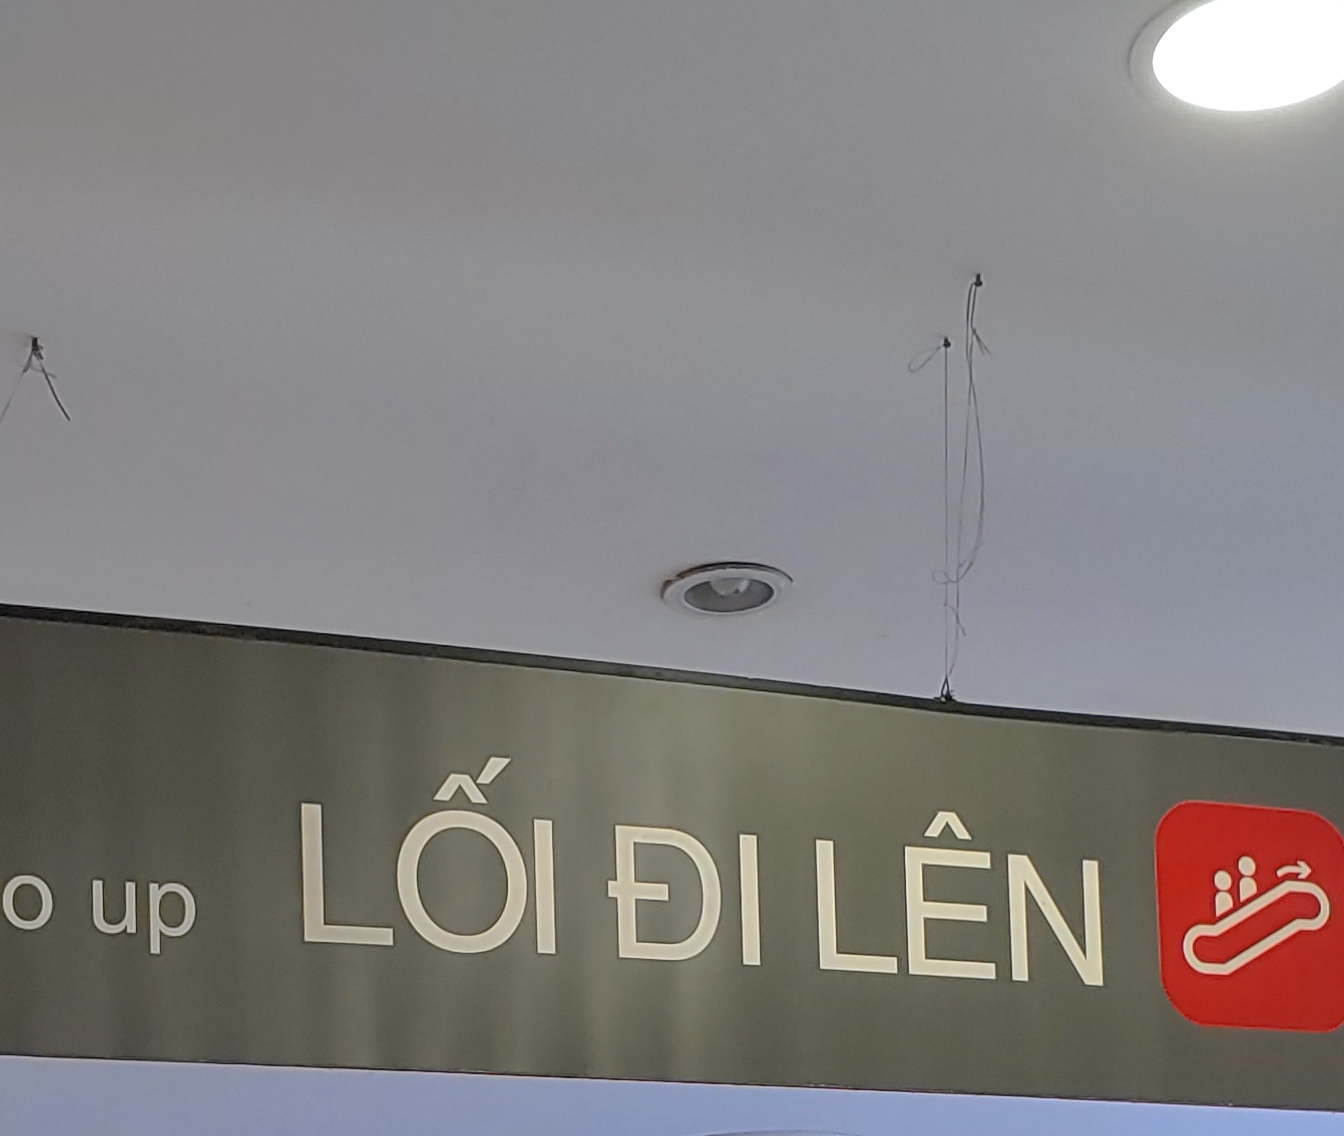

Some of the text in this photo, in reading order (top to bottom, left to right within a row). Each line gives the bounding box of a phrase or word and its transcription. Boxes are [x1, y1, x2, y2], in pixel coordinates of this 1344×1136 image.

[91, 880, 197, 955] up
[300, 757, 1104, 987] LỐI ĐI LÊN
